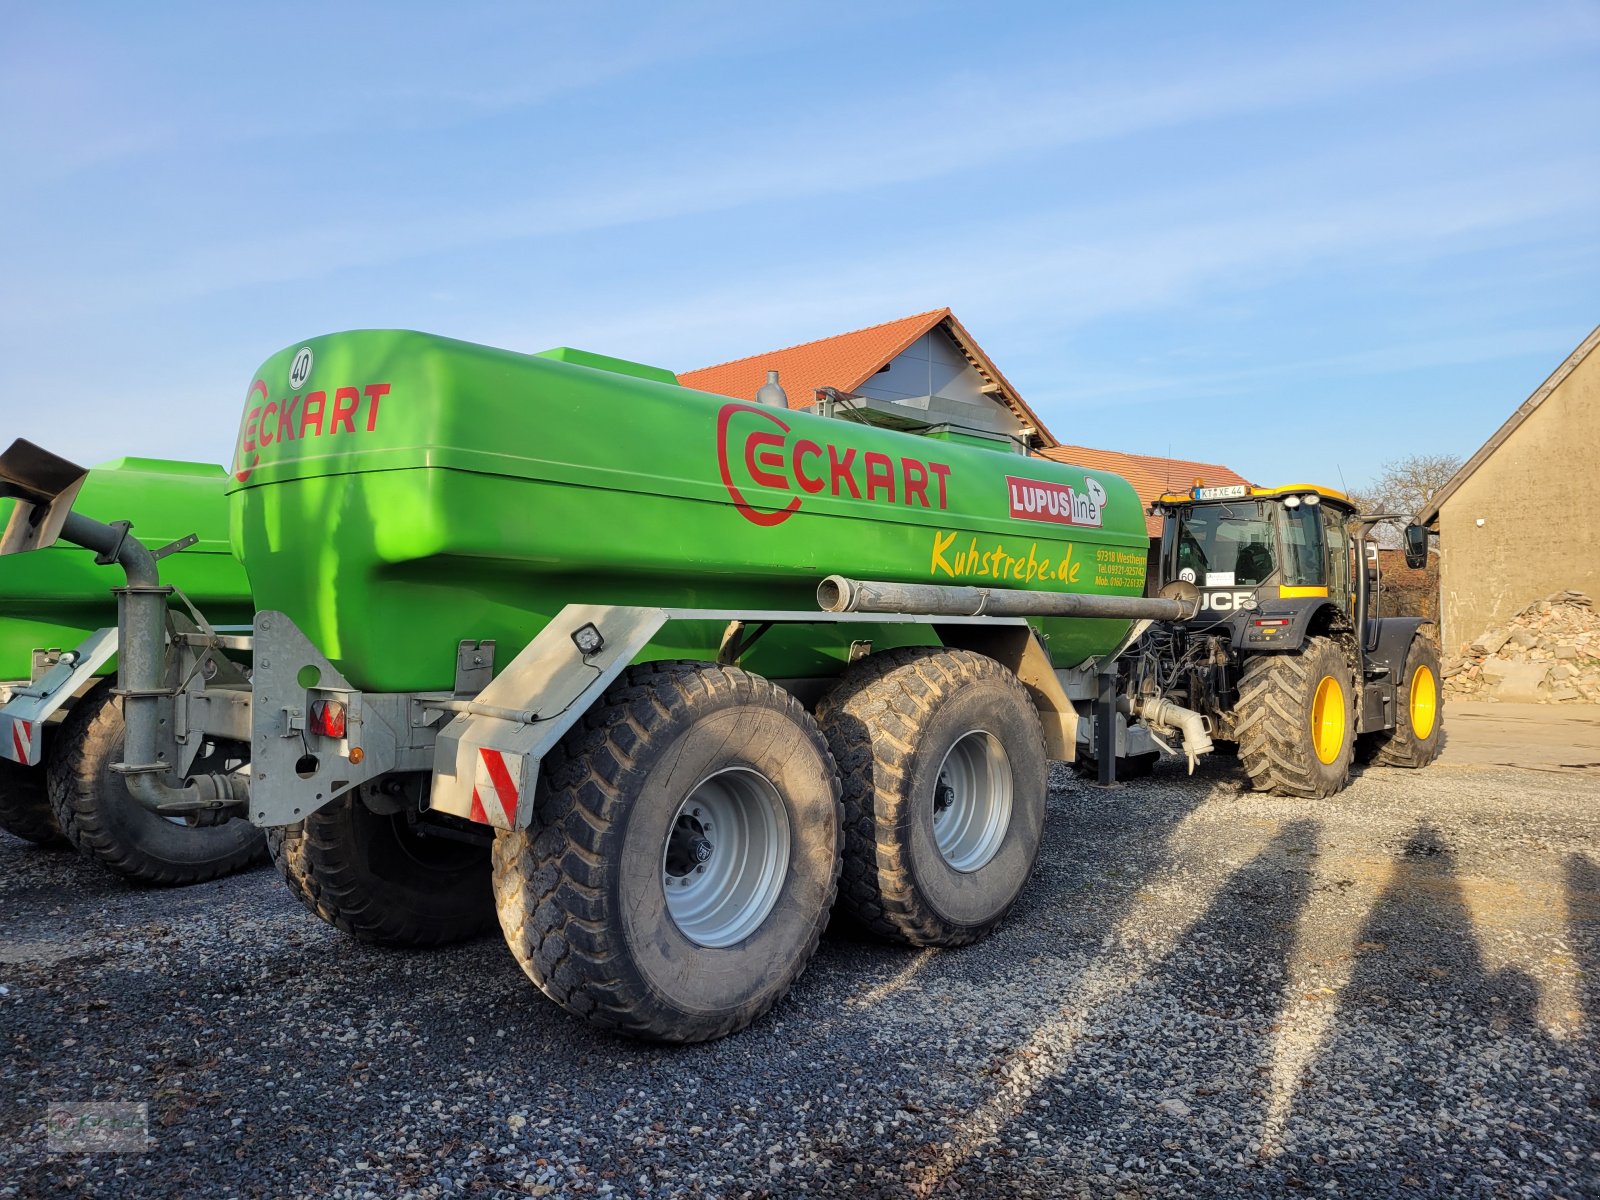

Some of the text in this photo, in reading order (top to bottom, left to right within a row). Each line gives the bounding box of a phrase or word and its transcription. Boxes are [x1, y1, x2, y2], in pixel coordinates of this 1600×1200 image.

[291, 353, 310, 383] 40
[242, 383, 392, 453] ECKART
[744, 430, 952, 510] ECKART
[1202, 486, 1242, 498] KT XE 44
[930, 530, 1081, 585] Kuhstrebe.de
[1096, 550, 1116, 563] 97318
[1181, 572, 1194, 582] 60
